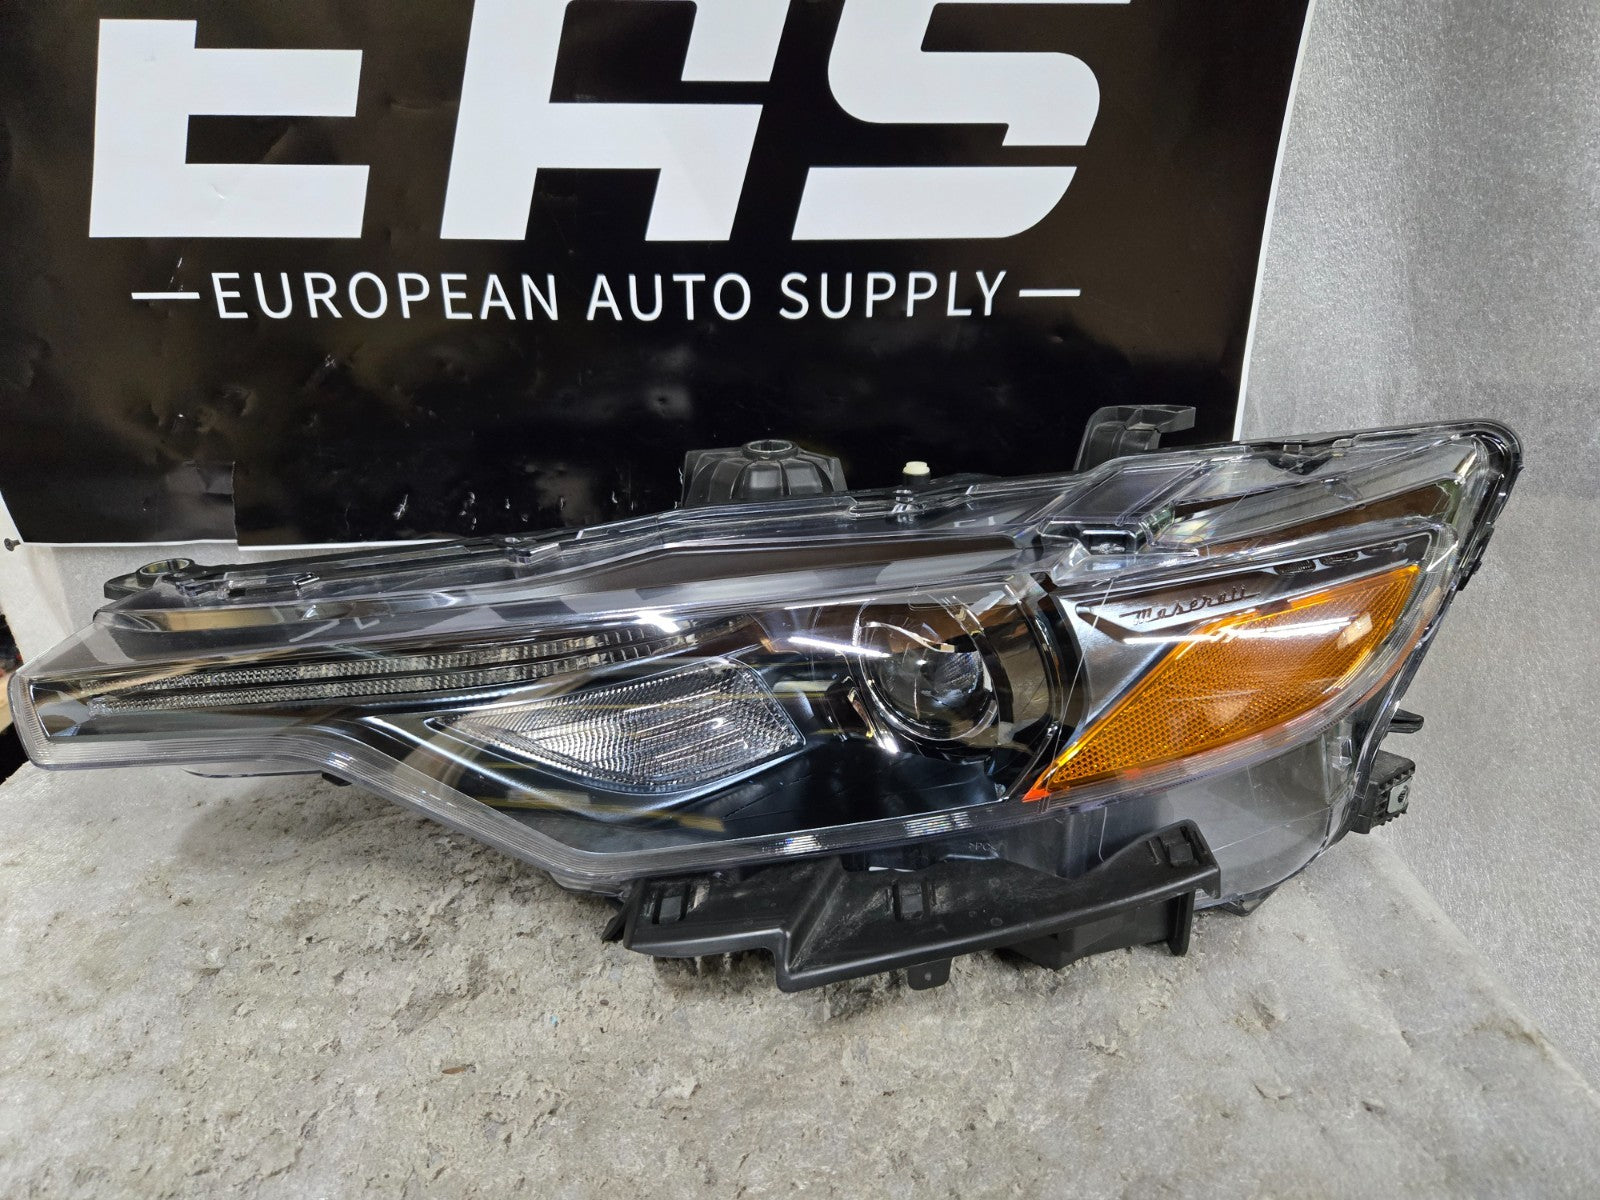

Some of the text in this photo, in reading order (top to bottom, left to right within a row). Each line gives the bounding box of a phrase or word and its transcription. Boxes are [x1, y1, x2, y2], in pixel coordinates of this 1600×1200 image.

[211, 270, 1007, 322] EUROPEAN AUTO SUPPLY
[1119, 584, 1260, 625] Maserati
